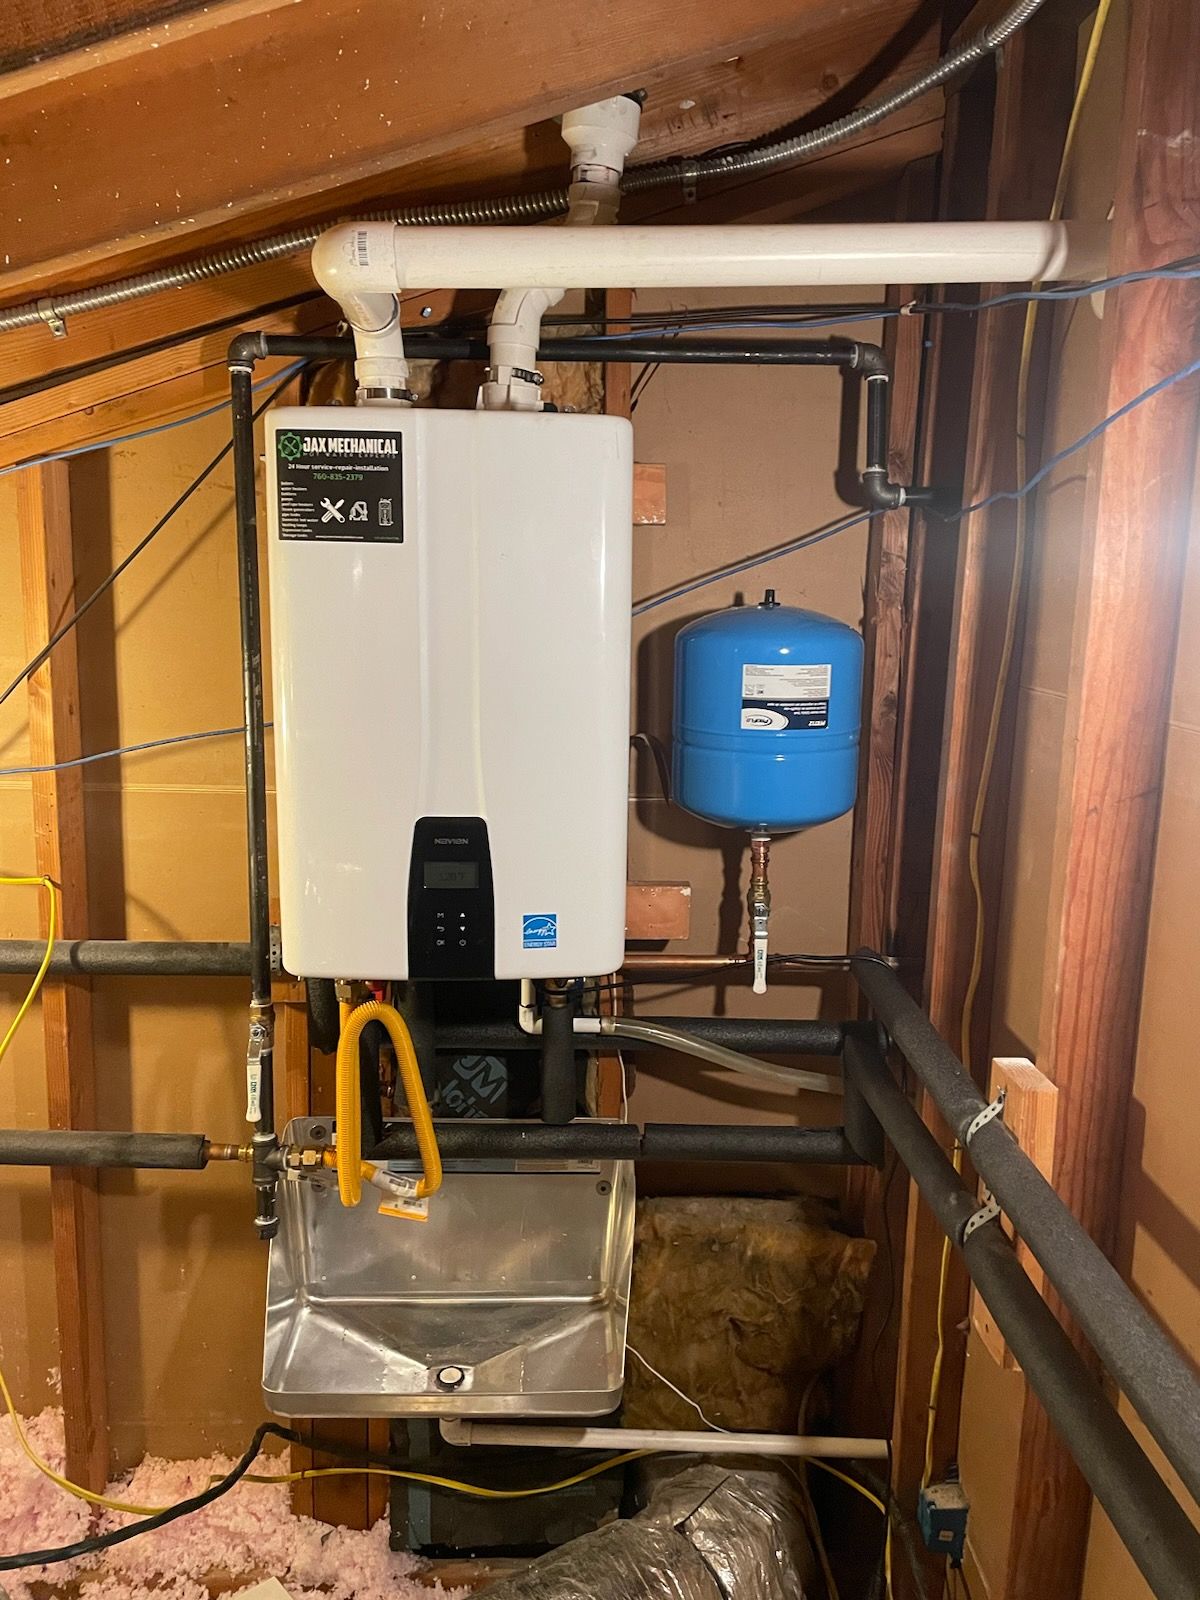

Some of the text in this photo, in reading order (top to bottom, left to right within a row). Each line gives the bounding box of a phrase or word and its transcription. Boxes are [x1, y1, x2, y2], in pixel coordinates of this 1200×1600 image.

[303, 437, 399, 455] JAX MECHANICAL
[313, 472, 364, 481] 760-835-2379
